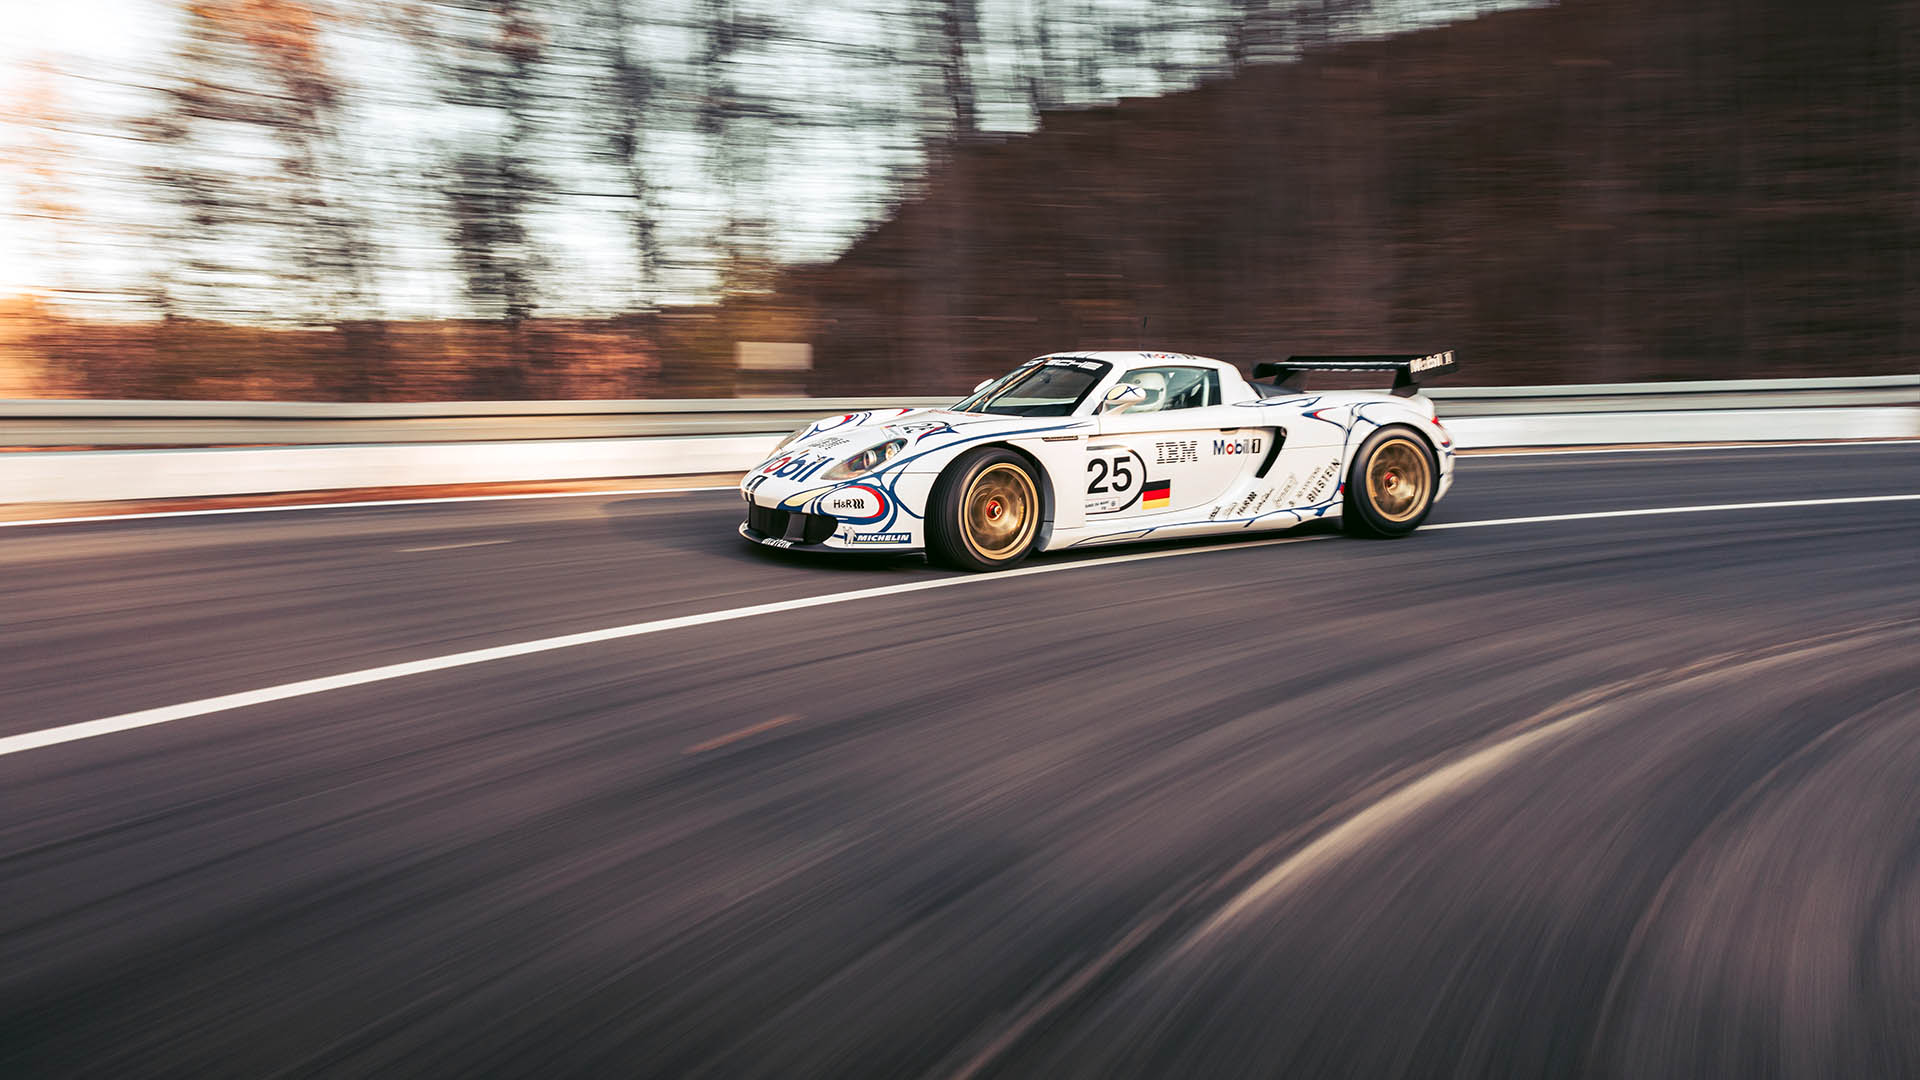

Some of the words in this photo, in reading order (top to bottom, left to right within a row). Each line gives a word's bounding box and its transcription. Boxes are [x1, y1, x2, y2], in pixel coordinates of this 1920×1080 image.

[1443, 350, 1455, 365] 1
[1155, 440, 1198, 464] IBM
[1213, 439, 1250, 455] Mobil
[1251, 438, 1261, 455] 1
[1087, 456, 1132, 494] 25
[1306, 458, 1342, 502] BILSTEIN
[834, 499, 852, 509] H&R
[855, 534, 909, 542] MICHELIN
